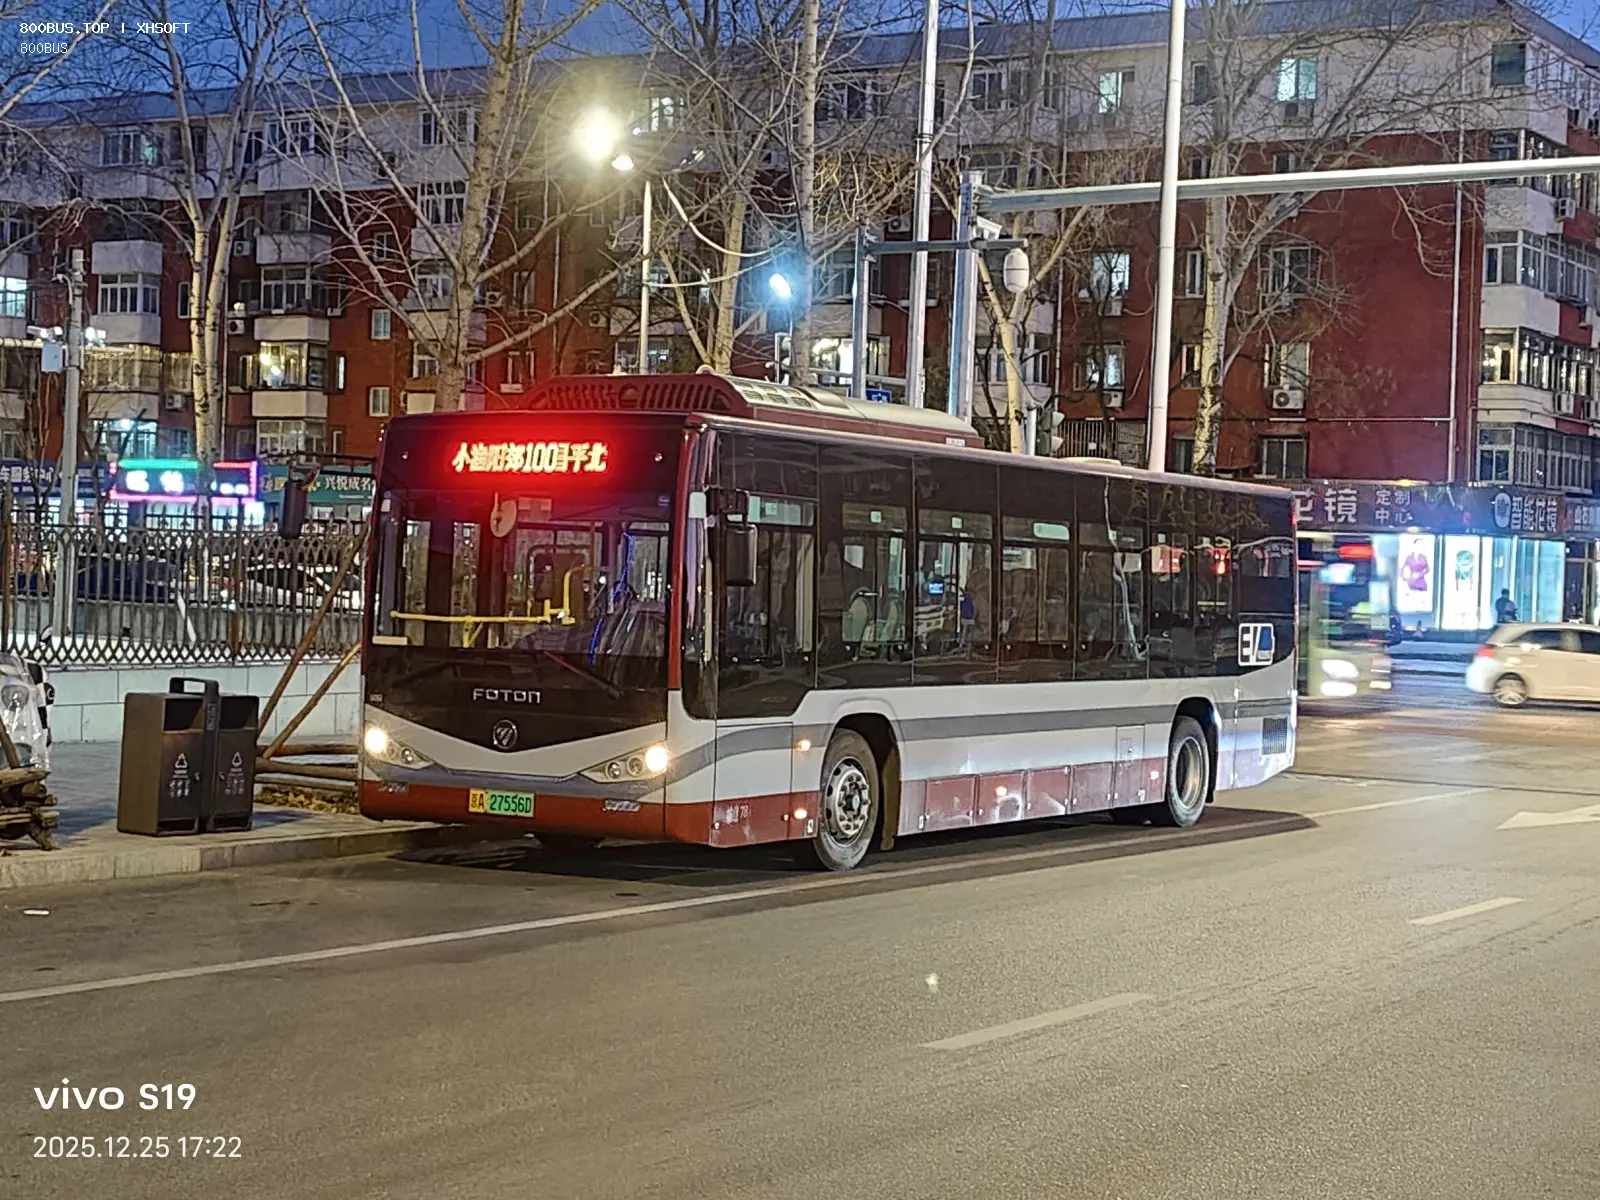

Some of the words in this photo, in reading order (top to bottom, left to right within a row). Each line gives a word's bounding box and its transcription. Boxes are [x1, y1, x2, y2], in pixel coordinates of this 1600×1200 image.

[1375, 489, 1411, 506] 定制
[1375, 507, 1413, 524] 中心
[472, 687, 541, 704] FOTON
